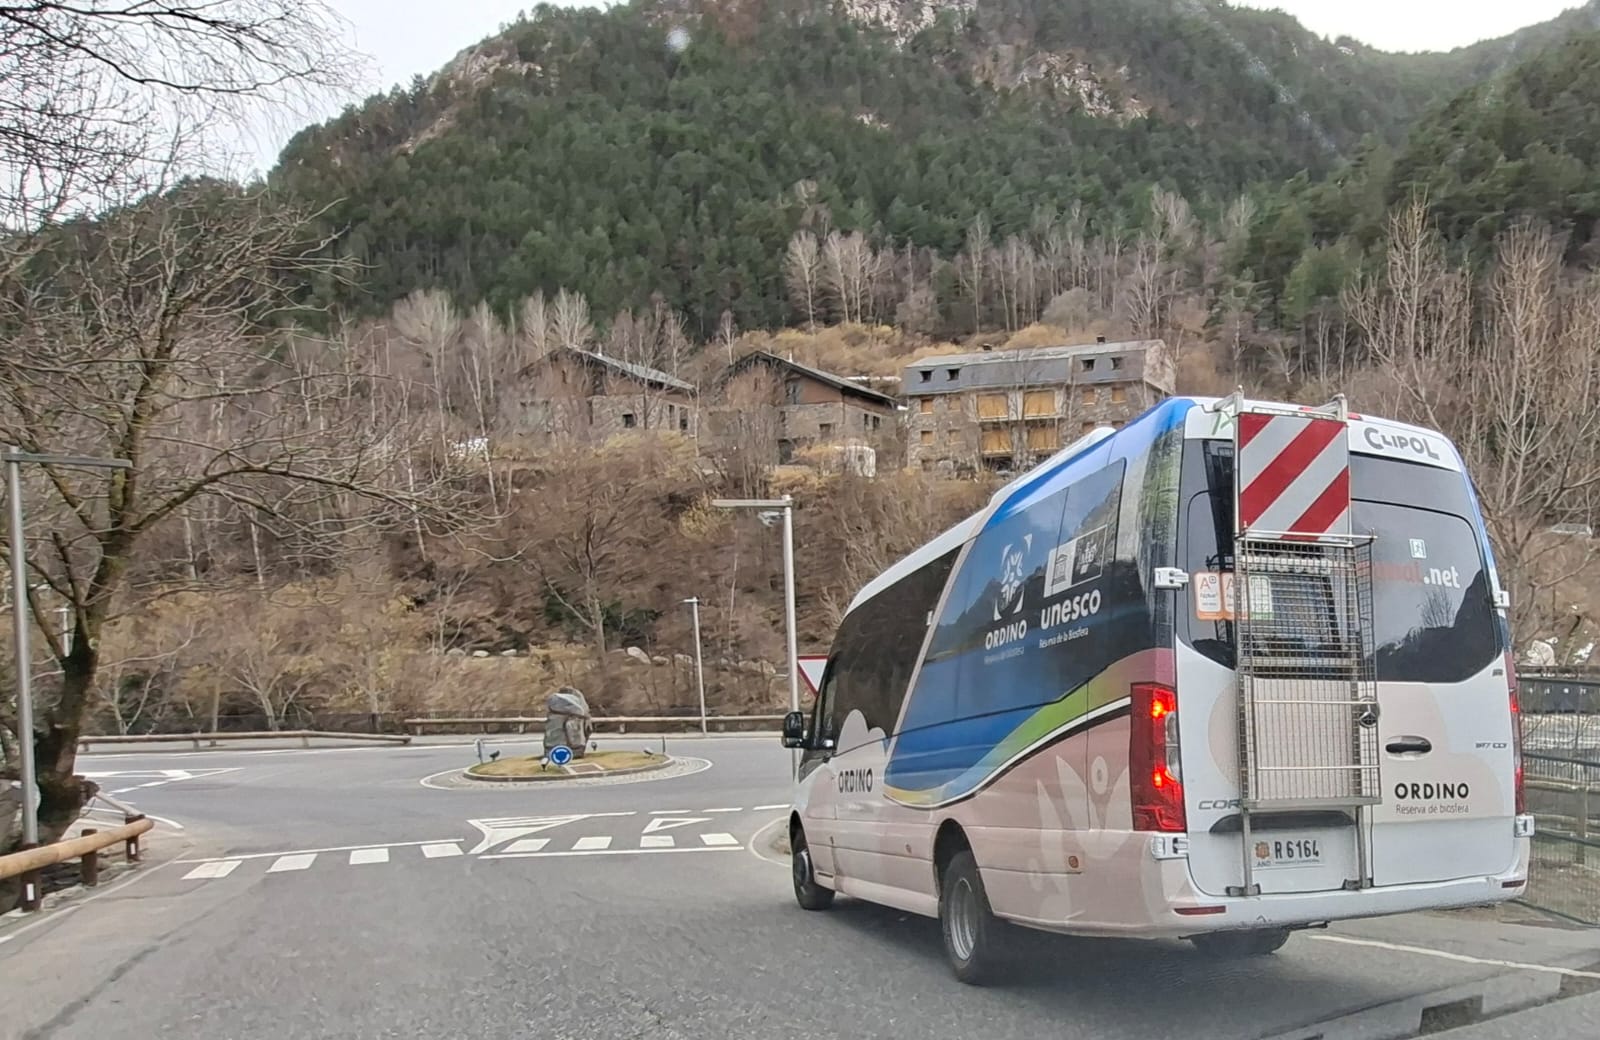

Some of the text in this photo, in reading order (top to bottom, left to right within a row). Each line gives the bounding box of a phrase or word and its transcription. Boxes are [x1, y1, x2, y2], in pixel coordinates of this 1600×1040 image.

[1364, 427, 1440, 460] CLIPOL
[1040, 589, 1101, 630] unesco
[985, 619, 1027, 650] ORDINO
[838, 767, 873, 793] ORDINO
[1394, 782, 1469, 800] ORDINO
[1396, 803, 1469, 815] Reserva de biosfera
[1274, 839, 1319, 859] R 6164
